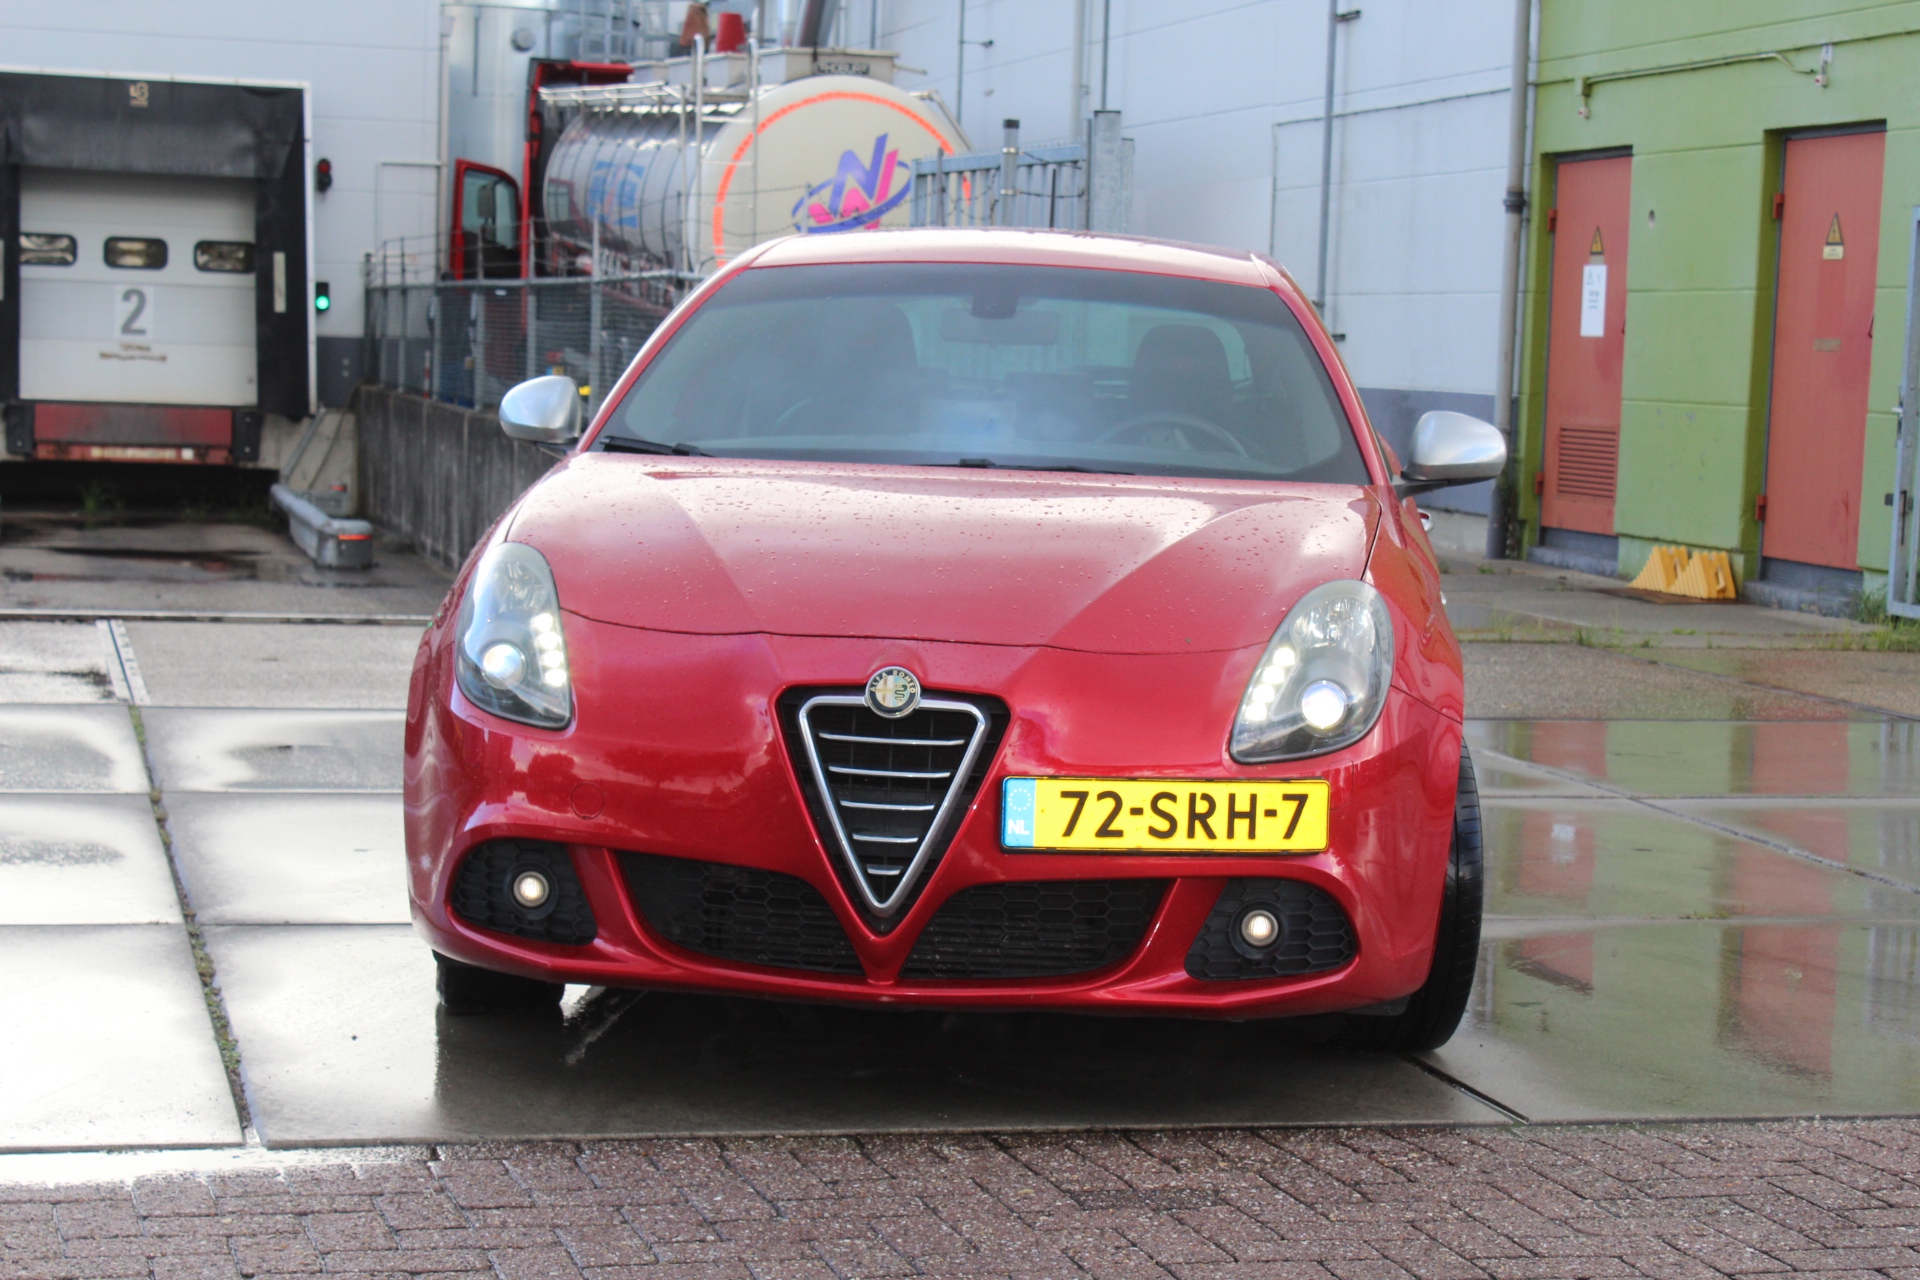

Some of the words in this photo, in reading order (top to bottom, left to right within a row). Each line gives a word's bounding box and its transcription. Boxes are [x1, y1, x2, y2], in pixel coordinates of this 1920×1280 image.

[121, 288, 147, 336] 2
[870, 672, 888, 692] ALFA
[892, 670, 916, 694] ROMEO
[1007, 819, 1030, 835] NL
[1059, 790, 1309, 840] 72-SRH-7
